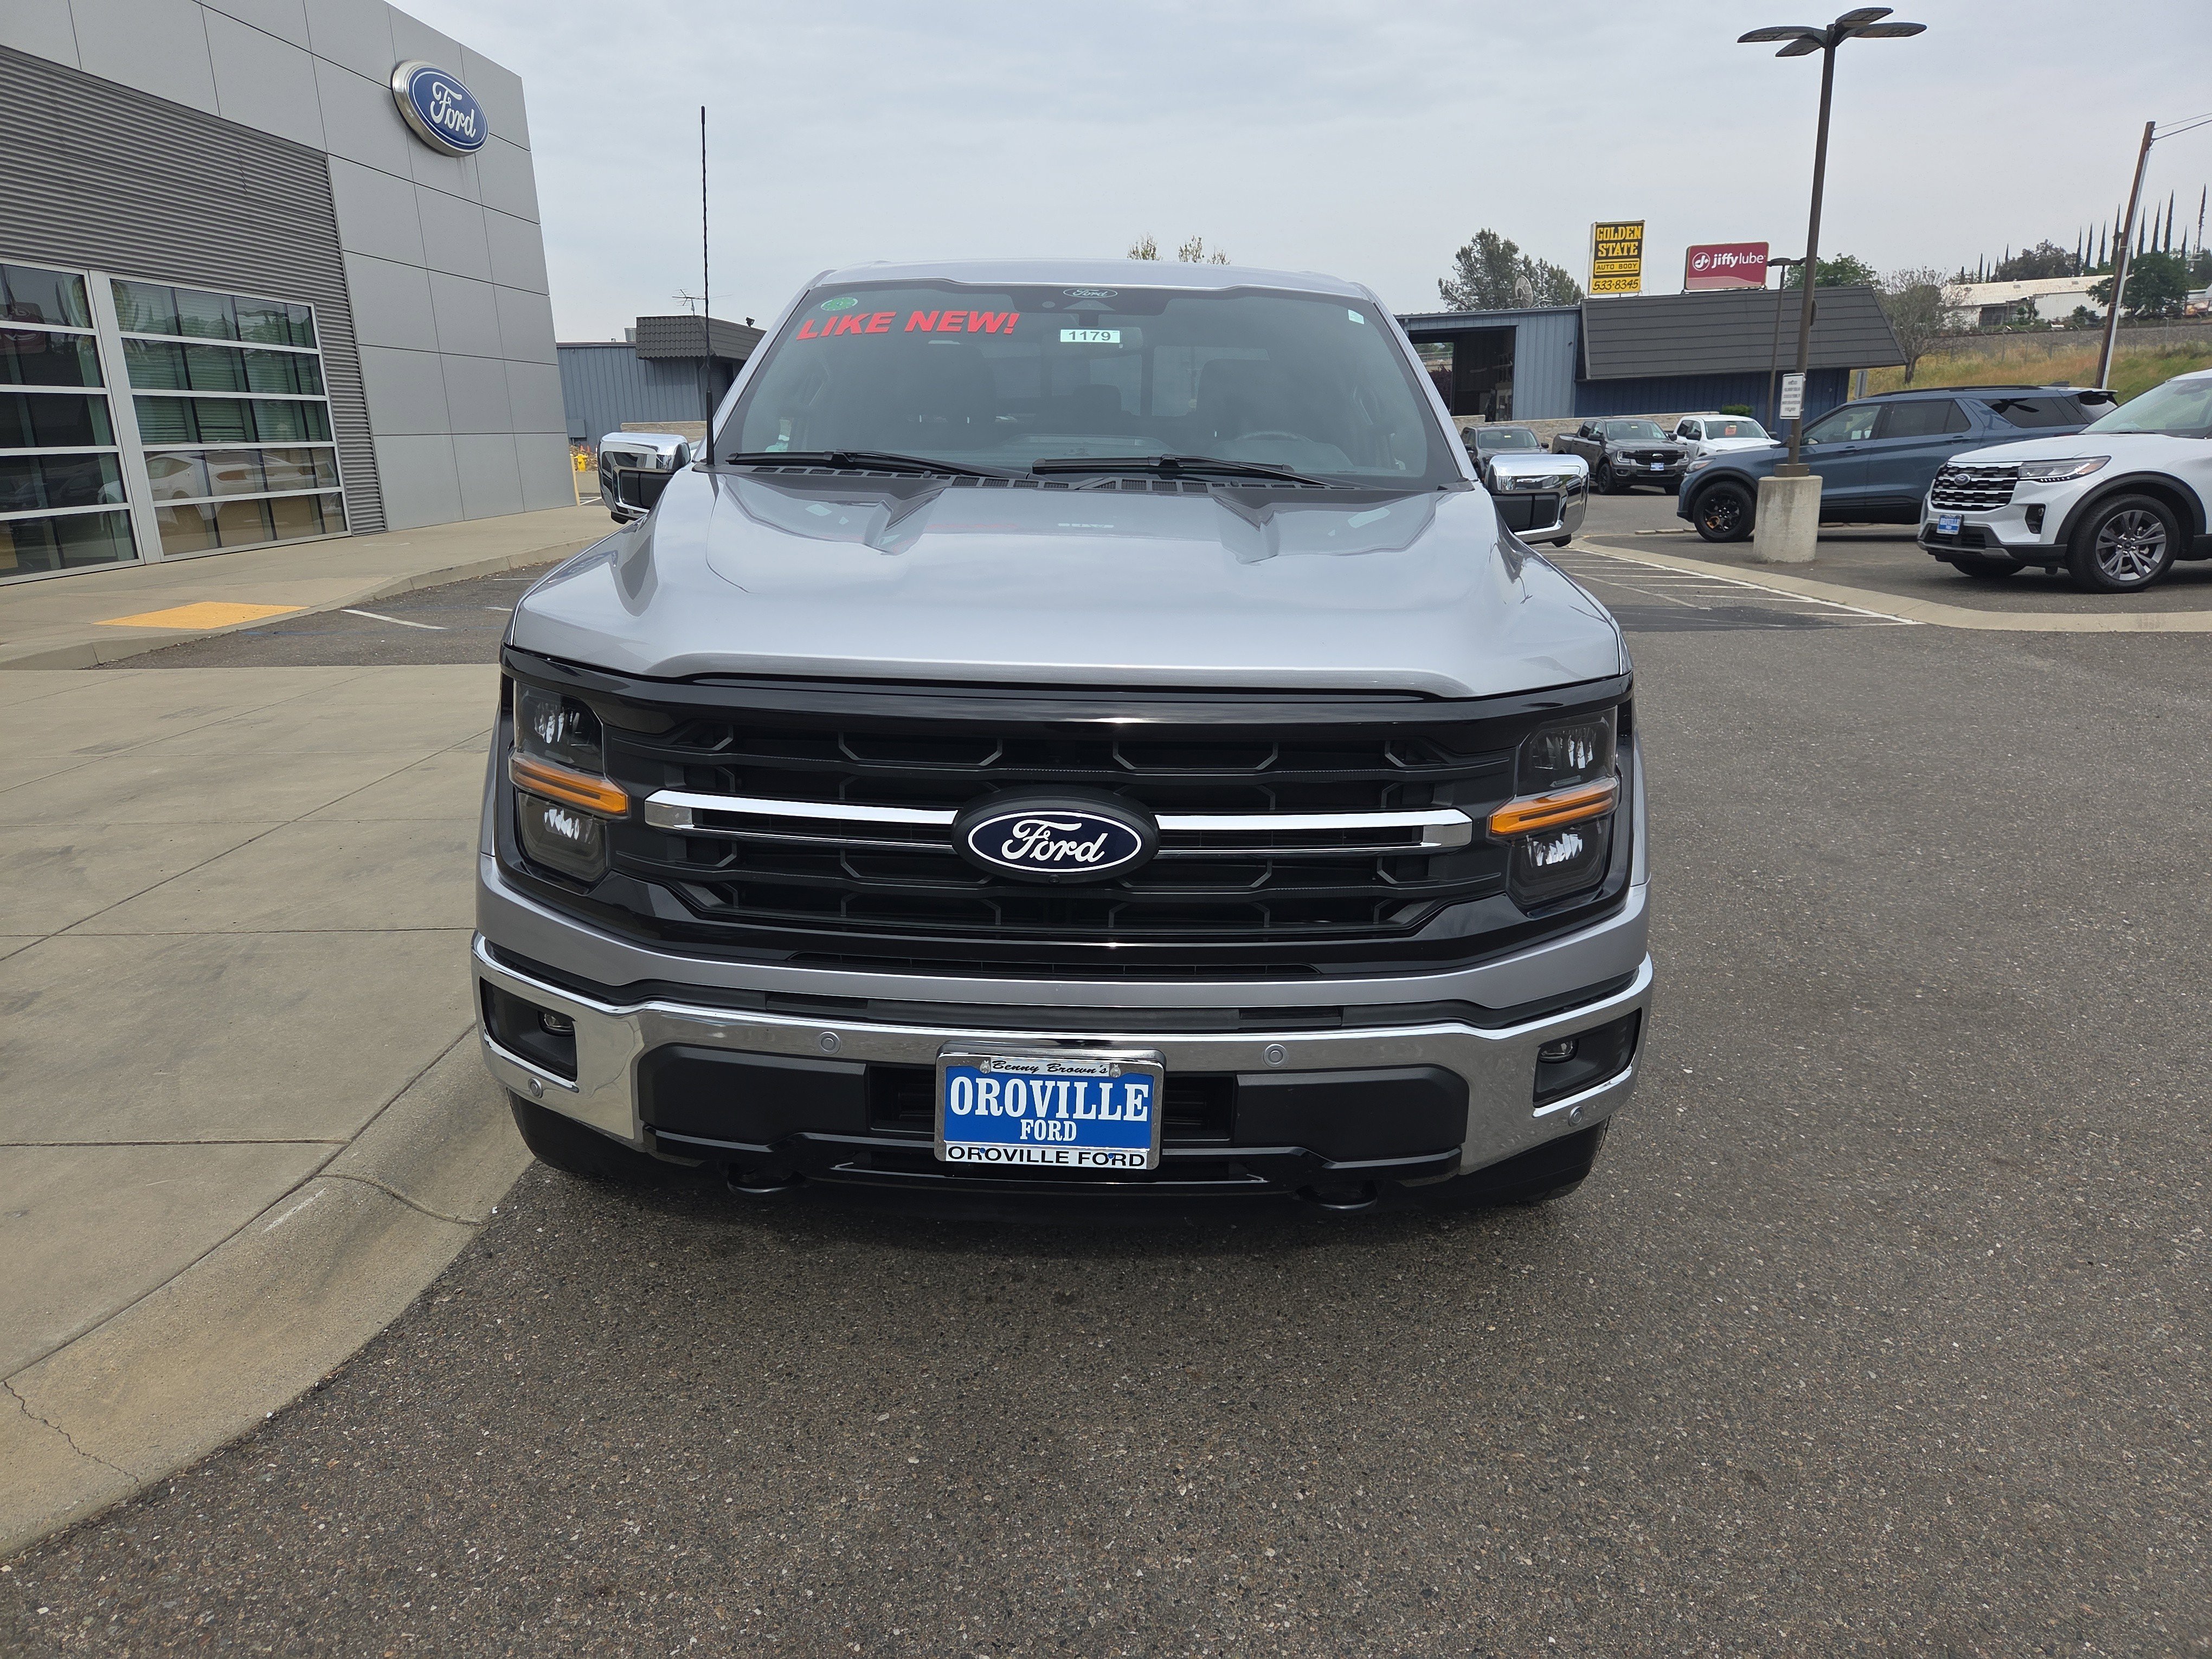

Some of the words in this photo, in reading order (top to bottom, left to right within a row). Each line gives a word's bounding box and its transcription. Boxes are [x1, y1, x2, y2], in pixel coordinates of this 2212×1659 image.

[430, 81, 476, 138] Ford
[1596, 226, 1642, 241] GOLDEN
[1598, 242, 1638, 257] STATE
[796, 311, 897, 340] LIKE
[904, 311, 1020, 334] NEW!
[1069, 331, 1111, 341] 1179
[1001, 819, 1108, 863] Ford
[992, 1060, 1039, 1073] Benny
[1046, 1063, 1108, 1074] Brown's
[950, 1076, 1149, 1122] OROVILLE
[1020, 1119, 1077, 1142] FORD
[948, 1145, 1070, 1165] OROVILLE
[1077, 1150, 1146, 1167] FORD
